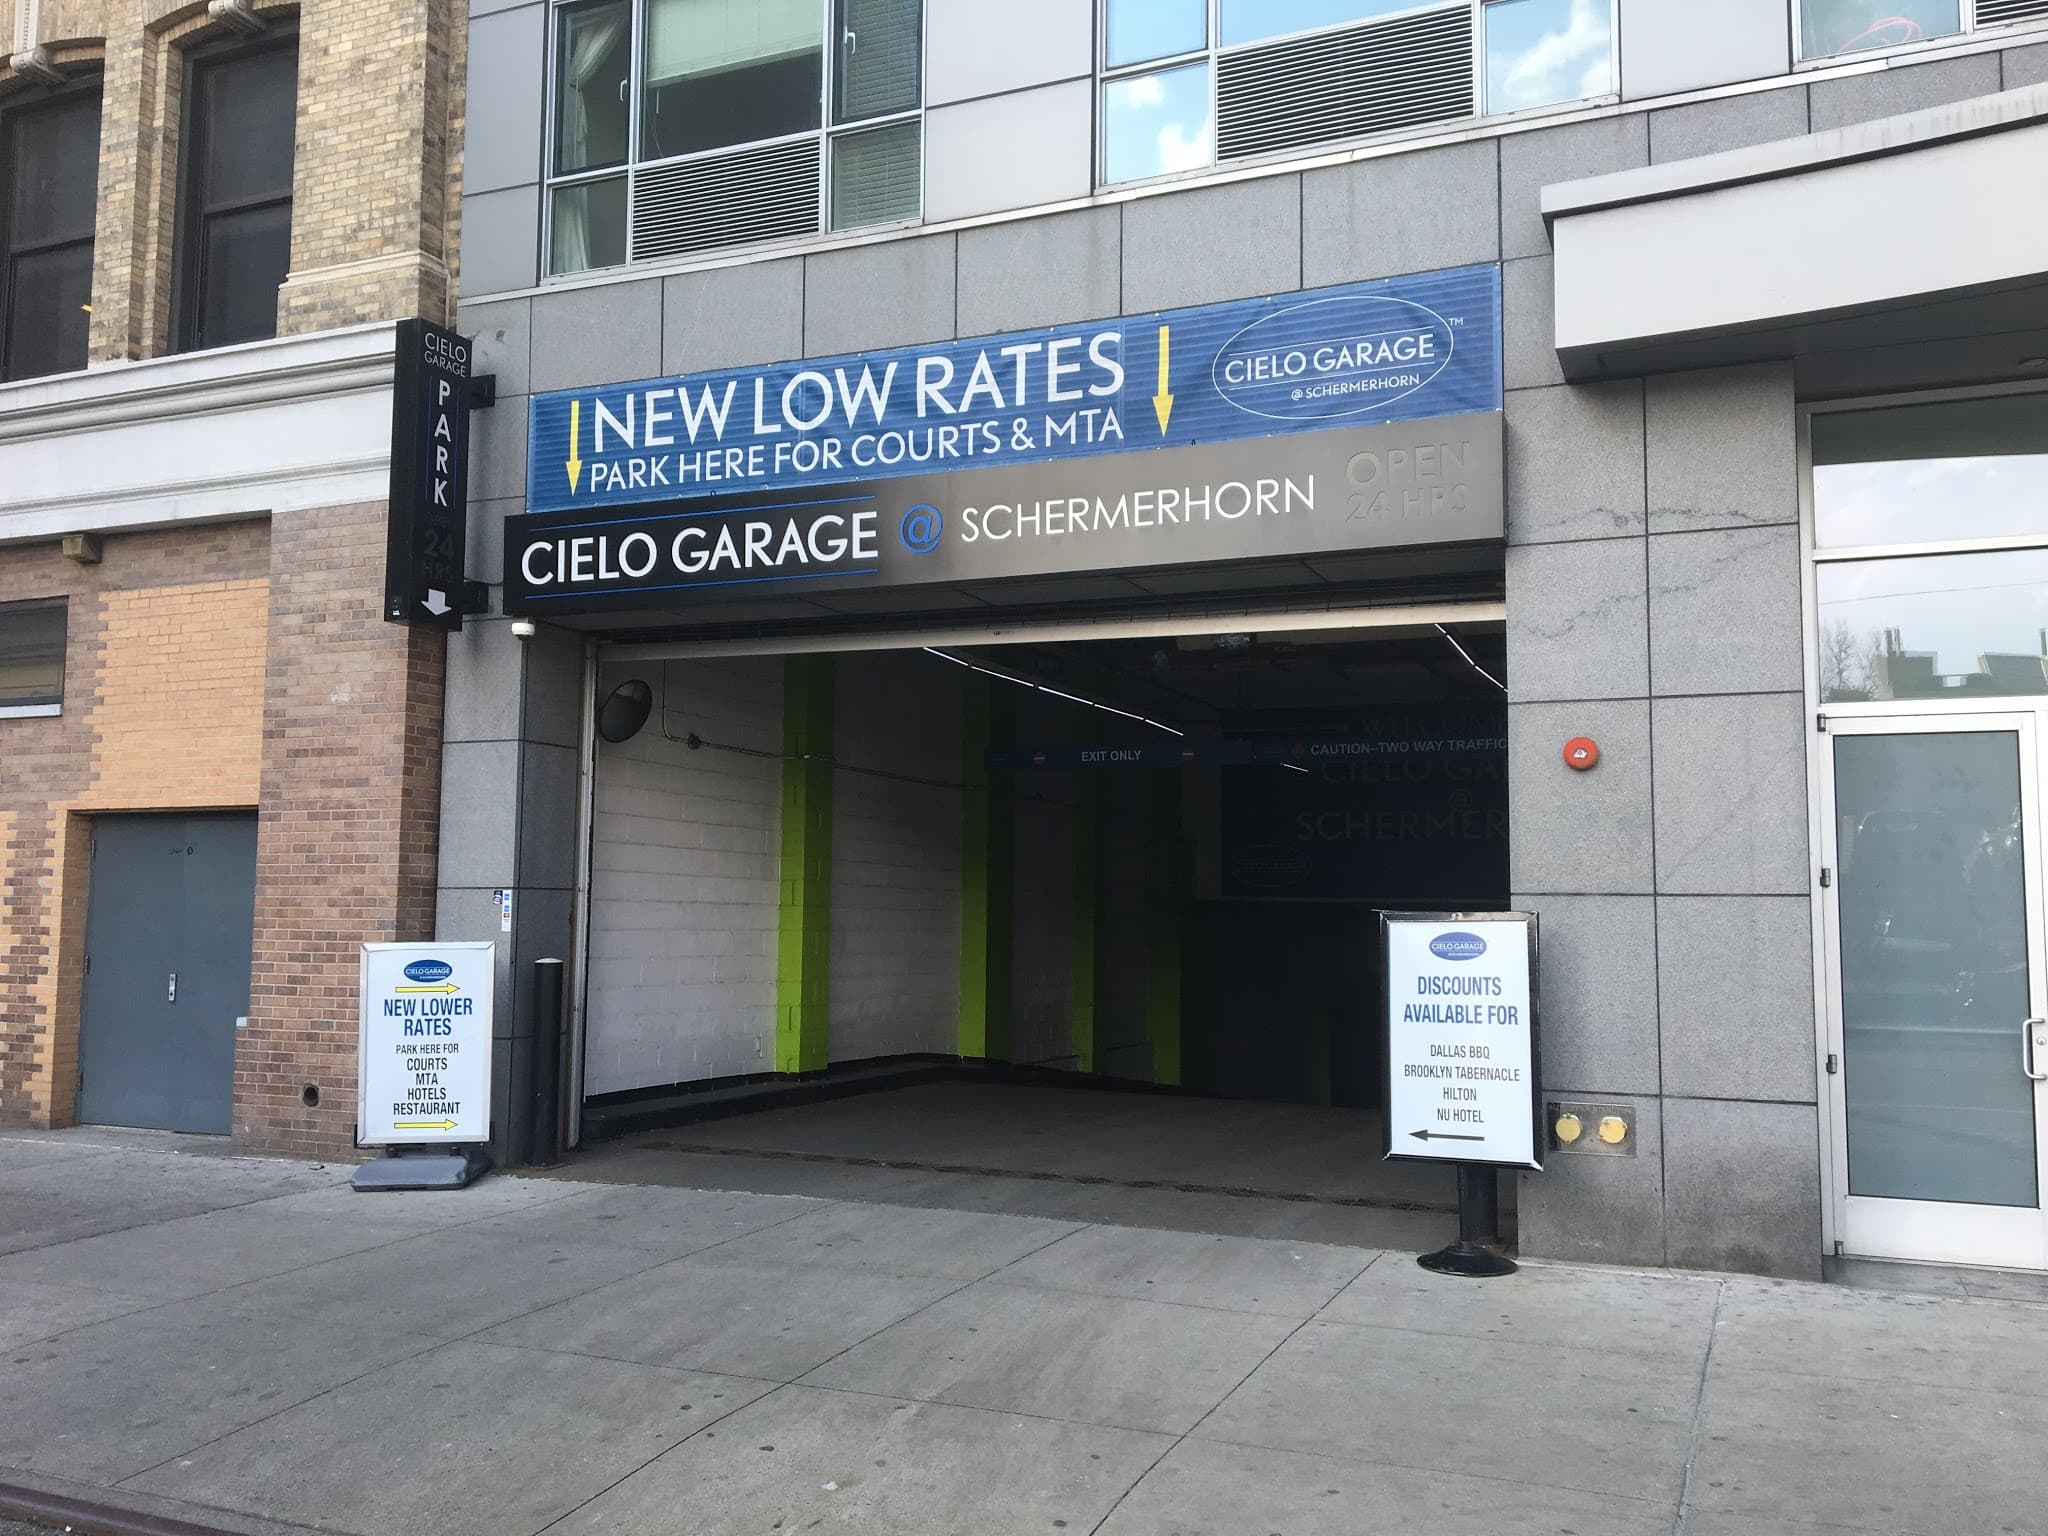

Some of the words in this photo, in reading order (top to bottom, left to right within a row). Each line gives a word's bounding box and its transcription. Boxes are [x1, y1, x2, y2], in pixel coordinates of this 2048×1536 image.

[425, 332, 467, 363] CIELO
[424, 350, 466, 378] GARAGE
[1224, 351, 1307, 383] CIELO
[1313, 333, 1435, 372] GARAGE
[595, 380, 738, 453] NEW
[753, 361, 899, 435] LOW
[916, 331, 1125, 418] RATES
[1291, 388, 1304, 401] @
[1306, 373, 1420, 398] SCHERMERHORN
[434, 379, 451, 507] PARK
[590, 455, 670, 493] PARK
[678, 445, 765, 483] HERE
[774, 438, 843, 474] FOR
[851, 418, 1000, 467] COURTS
[1010, 415, 1037, 450] &
[1045, 406, 1125, 445] MTA
[1345, 440, 1470, 487] OPEN
[1345, 490, 1390, 523] 24
[521, 530, 658, 586] CIELO
[671, 511, 880, 574] GARAGE
[900, 503, 944, 554] @
[960, 474, 1316, 543] SCHERMERHORN
[1412, 739, 1445, 752] WAY
[1447, 738, 1508, 751] TRAFFIC
[1081, 751, 1107, 762] EXIT
[1110, 749, 1143, 761] ONLY
[1417, 975, 1502, 996] DISCOUNTS
[384, 999, 417, 1017] NEW
[421, 997, 473, 1016] LOWER
[1403, 1004, 1483, 1024] AVAILABLE
[1488, 1005, 1519, 1026] FOR
[404, 1018, 452, 1036] RATES
[396, 1044, 418, 1055] PARK
[420, 1043, 441, 1054] HERE
[443, 1043, 459, 1054] FOR
[1430, 1044, 1466, 1058] DALLAS
[1469, 1046, 1490, 1060] BBQ
[406, 1058, 448, 1071] COURTS
[1404, 1064, 1452, 1079] BROOKLYN
[1455, 1066, 1521, 1082] TABERNACLE
[415, 1073, 439, 1085] MTA
[407, 1087, 447, 1100] HOTELS
[1443, 1087, 1477, 1101] HILTON
[393, 1102, 461, 1115] RESTAURANT
[1437, 1108, 1450, 1121] NU
[1453, 1109, 1484, 1123] HOTEL
